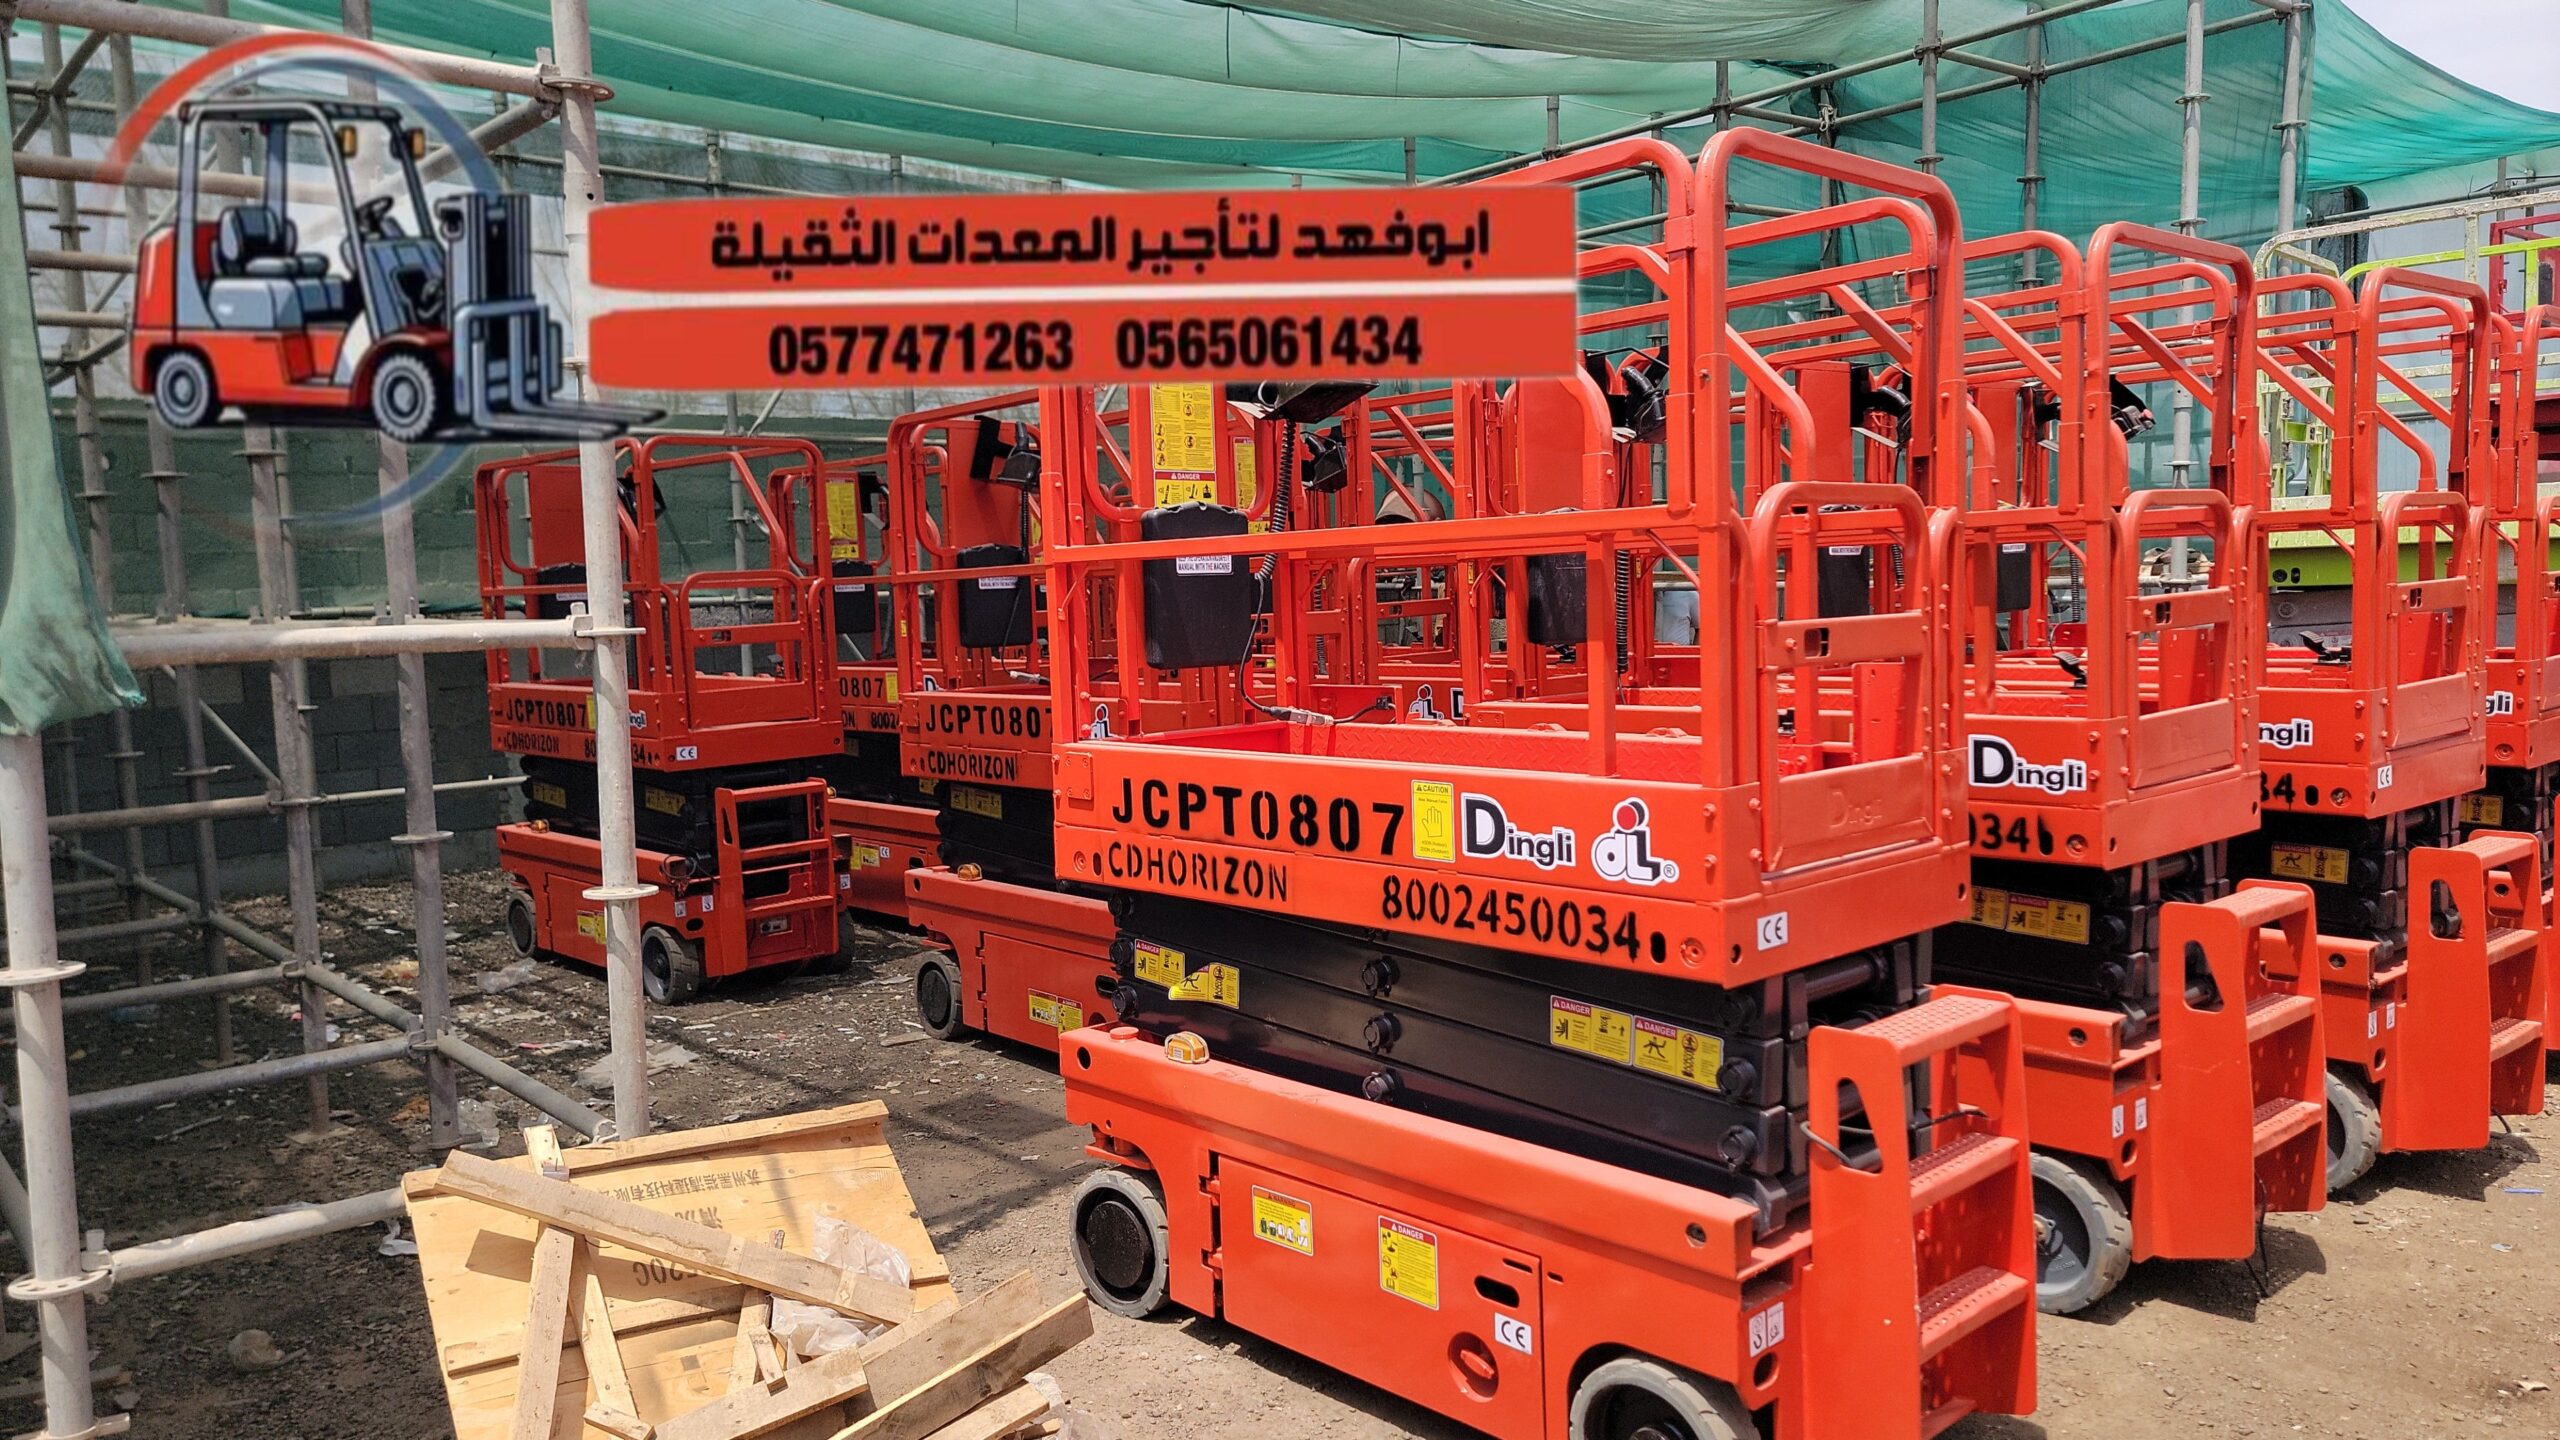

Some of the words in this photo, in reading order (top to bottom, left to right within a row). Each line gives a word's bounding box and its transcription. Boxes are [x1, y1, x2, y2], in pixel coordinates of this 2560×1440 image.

[840, 677, 883, 698] 0807
[507, 697, 586, 727] JCPT0807
[2259, 722, 2310, 746] ngli
[679, 747, 695, 759] CE
[928, 751, 1016, 781] CDHORIZON
[1973, 739, 2083, 792] Dingli
[1423, 784, 1449, 794] CAUTION
[1112, 777, 1404, 856] JCPT0807
[1465, 799, 1572, 867] Dingli
[1108, 841, 1287, 901] CDHORIZON
[1382, 874, 1640, 962] 8002450034
[1763, 916, 1783, 944] CE
[1560, 1001, 1591, 1015] DANGER
[1644, 1025, 1677, 1038] DANGER
[1398, 1225, 1424, 1241] DANGER
[1501, 1320, 1526, 1348] CE
